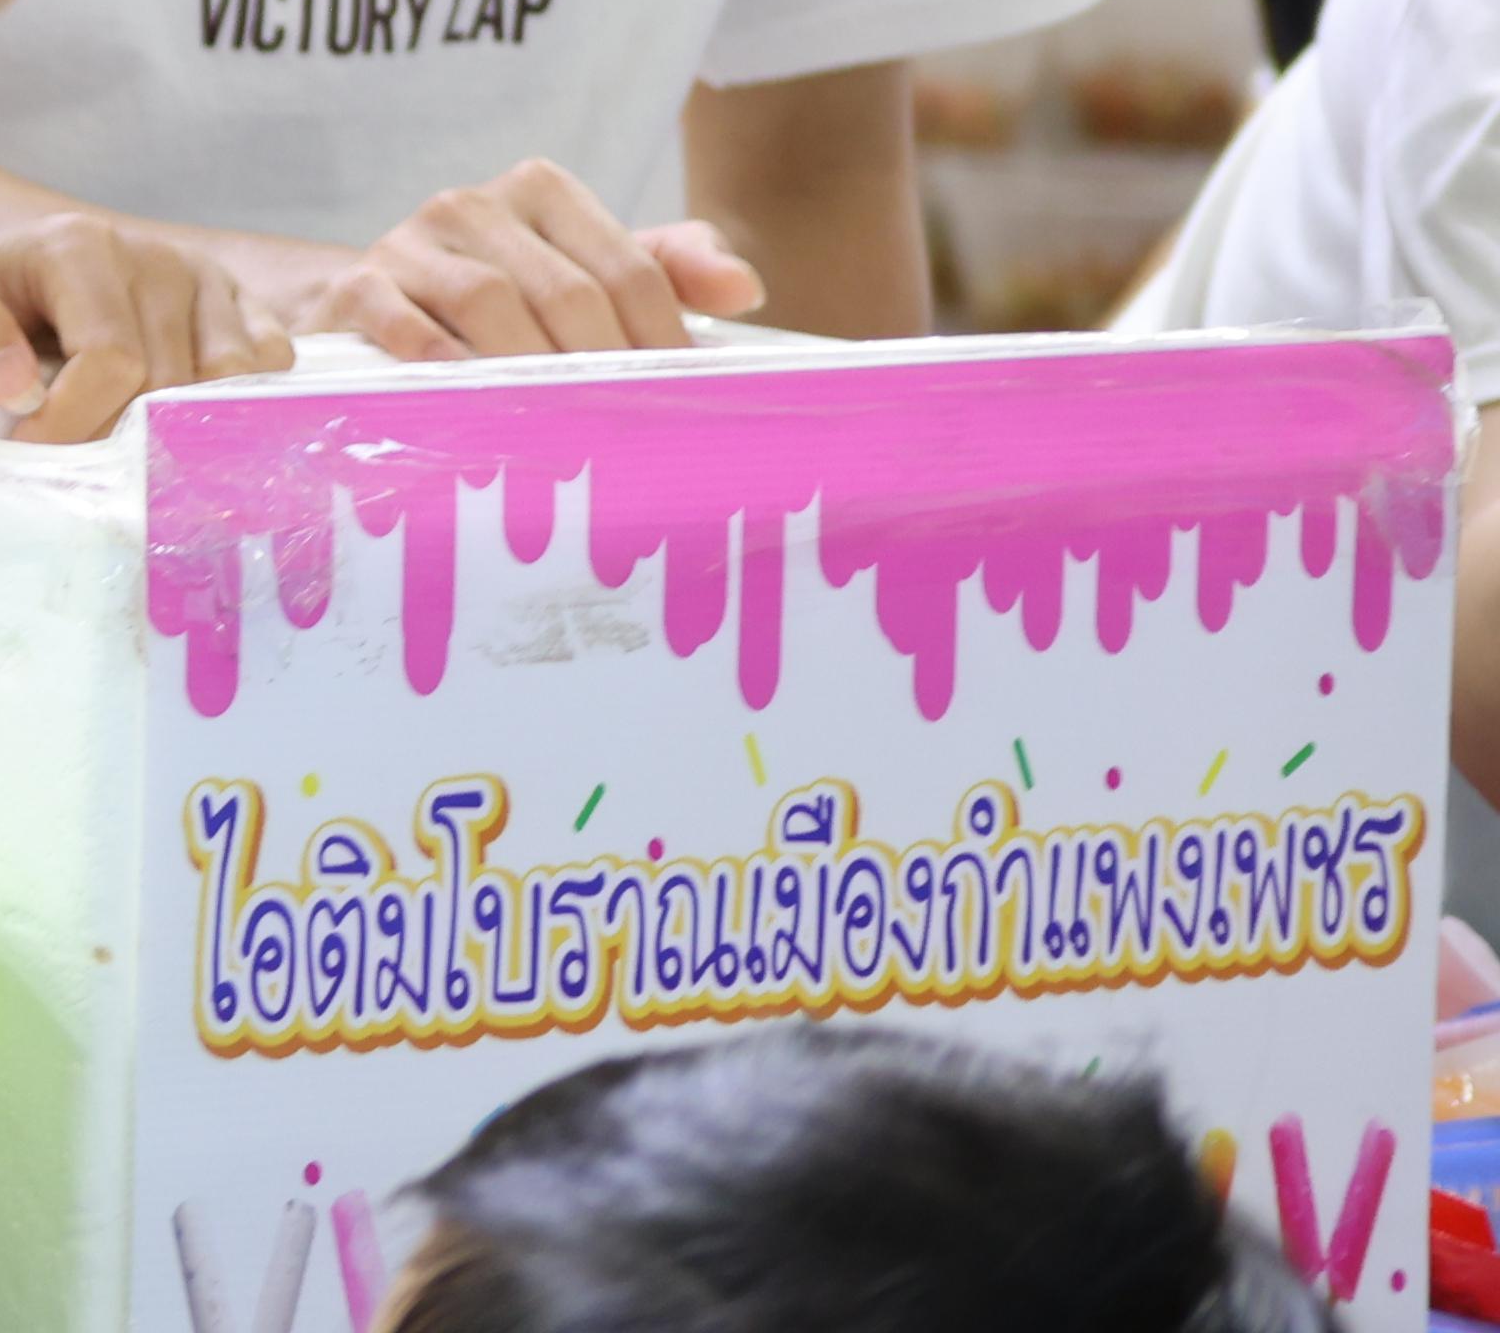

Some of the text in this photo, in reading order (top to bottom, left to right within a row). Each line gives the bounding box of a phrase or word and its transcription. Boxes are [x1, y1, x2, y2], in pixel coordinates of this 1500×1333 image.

[198, 788, 1407, 1026] ไอติมโบราณเมืองกำแพงเพชร
